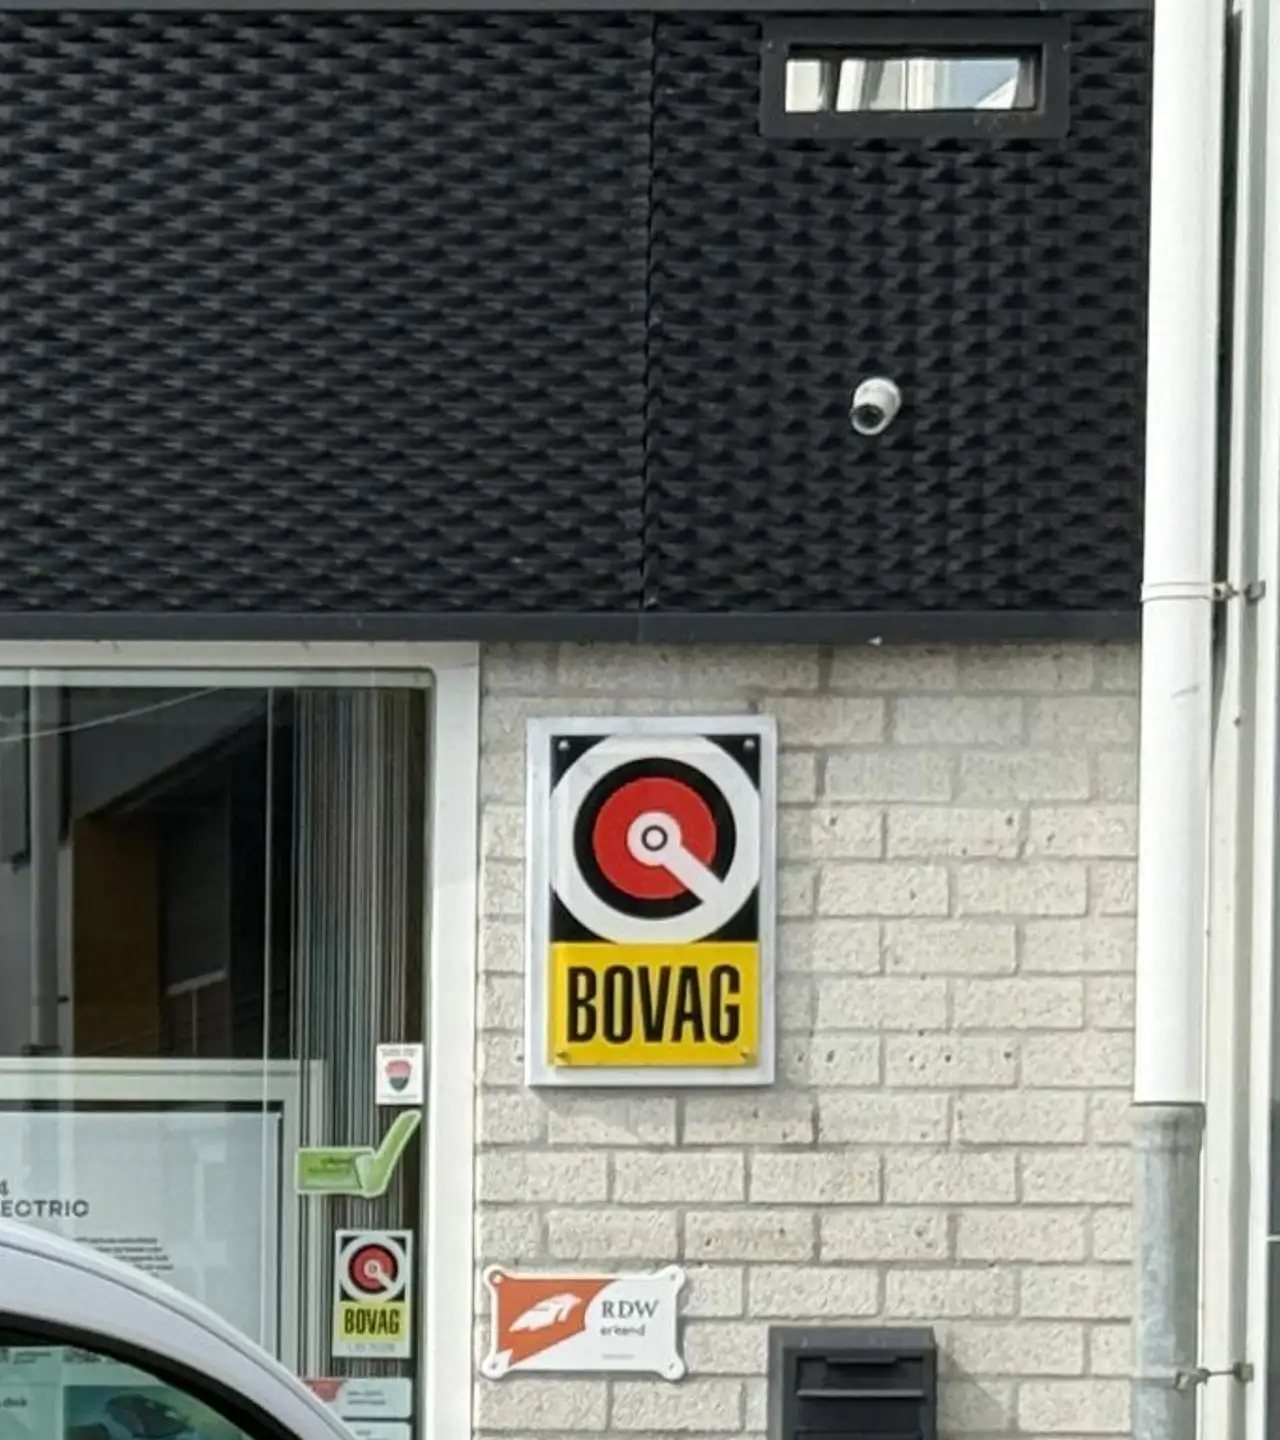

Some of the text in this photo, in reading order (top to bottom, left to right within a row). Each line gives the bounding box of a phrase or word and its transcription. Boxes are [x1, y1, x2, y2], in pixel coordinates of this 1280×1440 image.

[567, 964, 740, 1044] BOVAG
[344, 1308, 400, 1335] BOVAG
[602, 1299, 660, 1319] RDW
